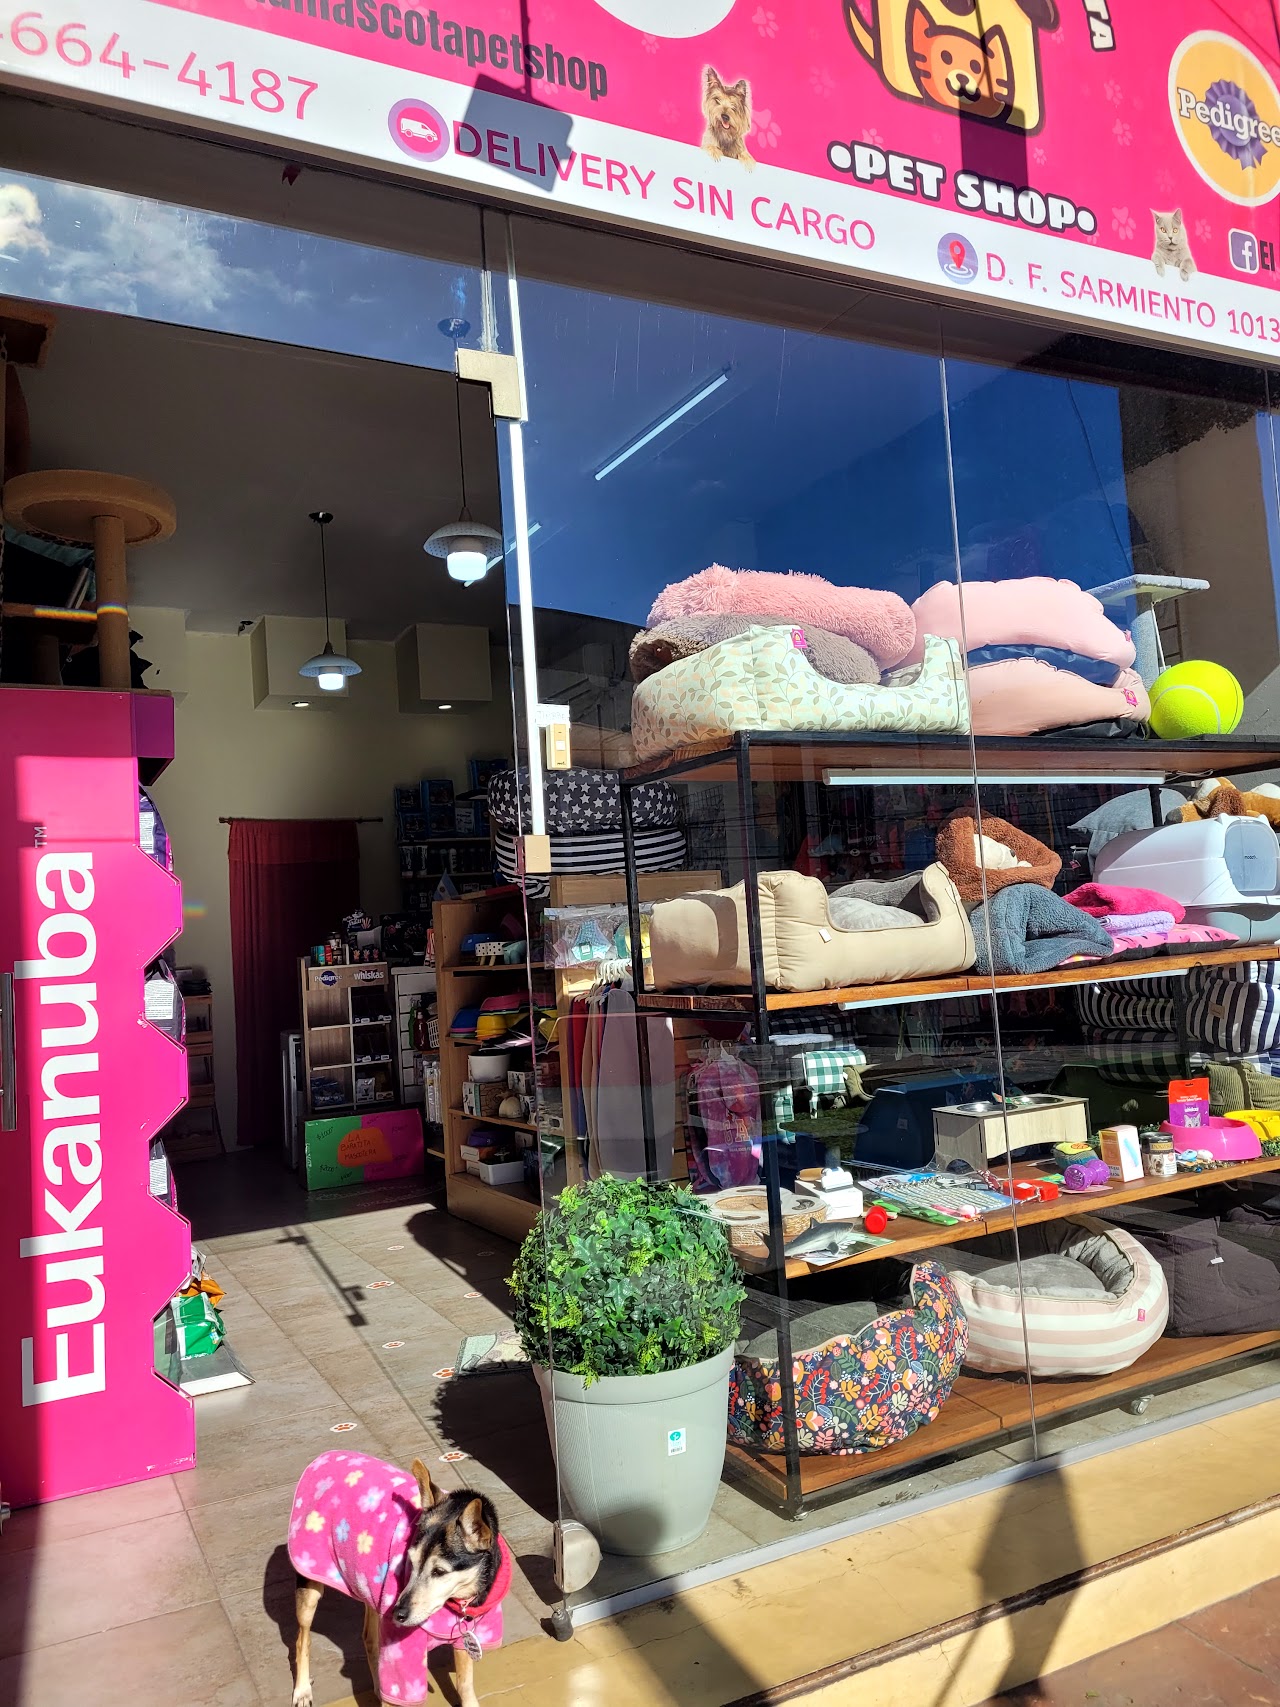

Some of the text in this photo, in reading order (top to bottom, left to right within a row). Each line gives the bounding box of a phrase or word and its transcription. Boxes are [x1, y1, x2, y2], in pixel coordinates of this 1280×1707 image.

[1177, 87, 1280, 148] Pedigree
[454, 122, 876, 251] DELIVERY SIN CARGO
[986, 251, 1280, 344] D. F. SARMIENTO 1013
[354, 970, 384, 980] whiskas
[14, 852, 106, 1408] Eukanuba
[348, 1134, 361, 1142] LA
